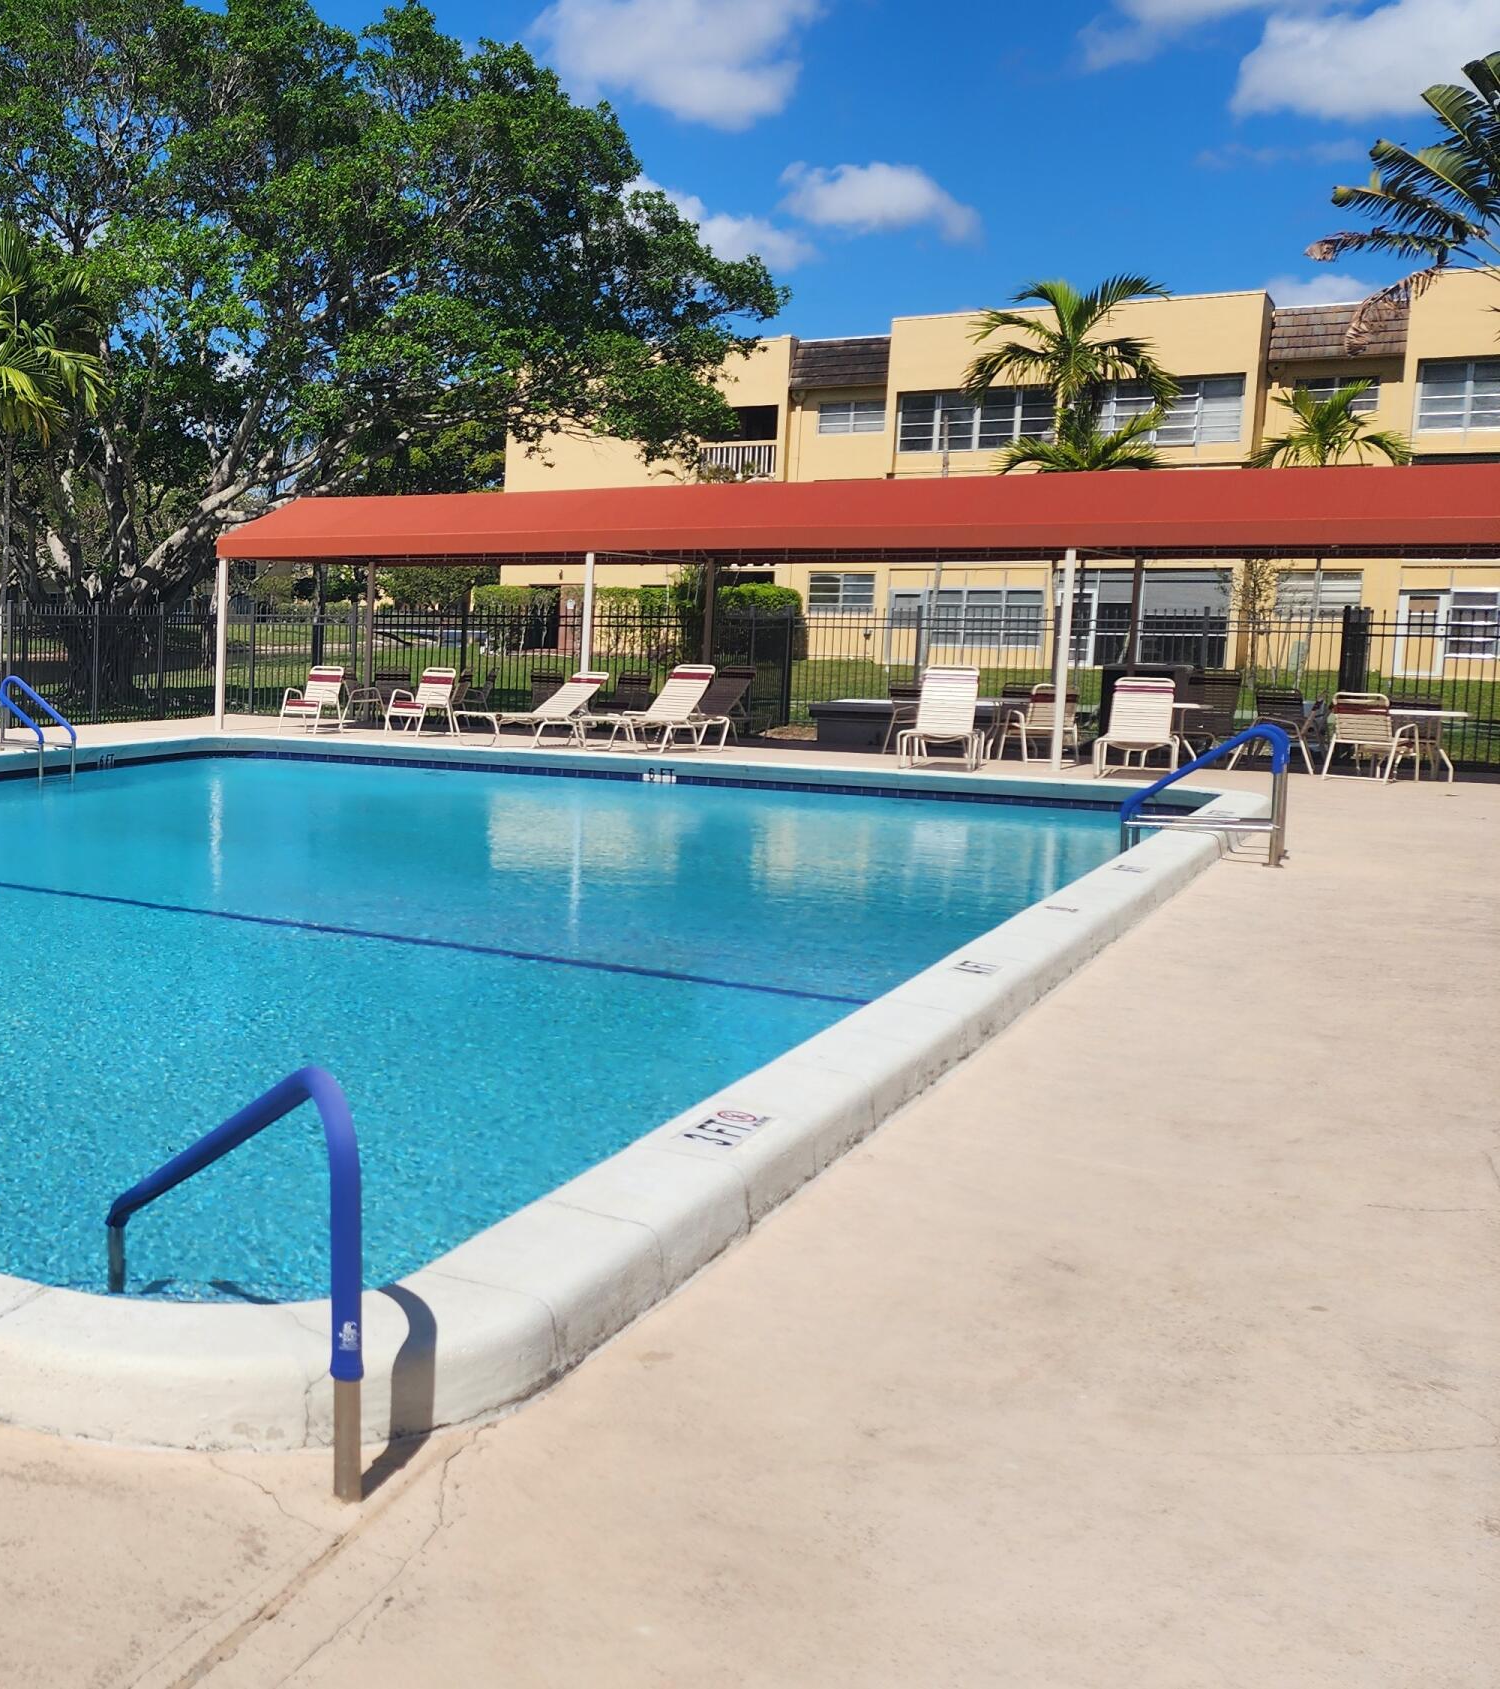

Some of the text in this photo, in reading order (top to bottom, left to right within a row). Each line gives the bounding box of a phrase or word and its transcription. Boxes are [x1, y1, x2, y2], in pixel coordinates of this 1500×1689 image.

[648, 767, 676, 783] 6 FT
[696, 1118, 753, 1138] FT
[683, 1133, 733, 1146] 3
